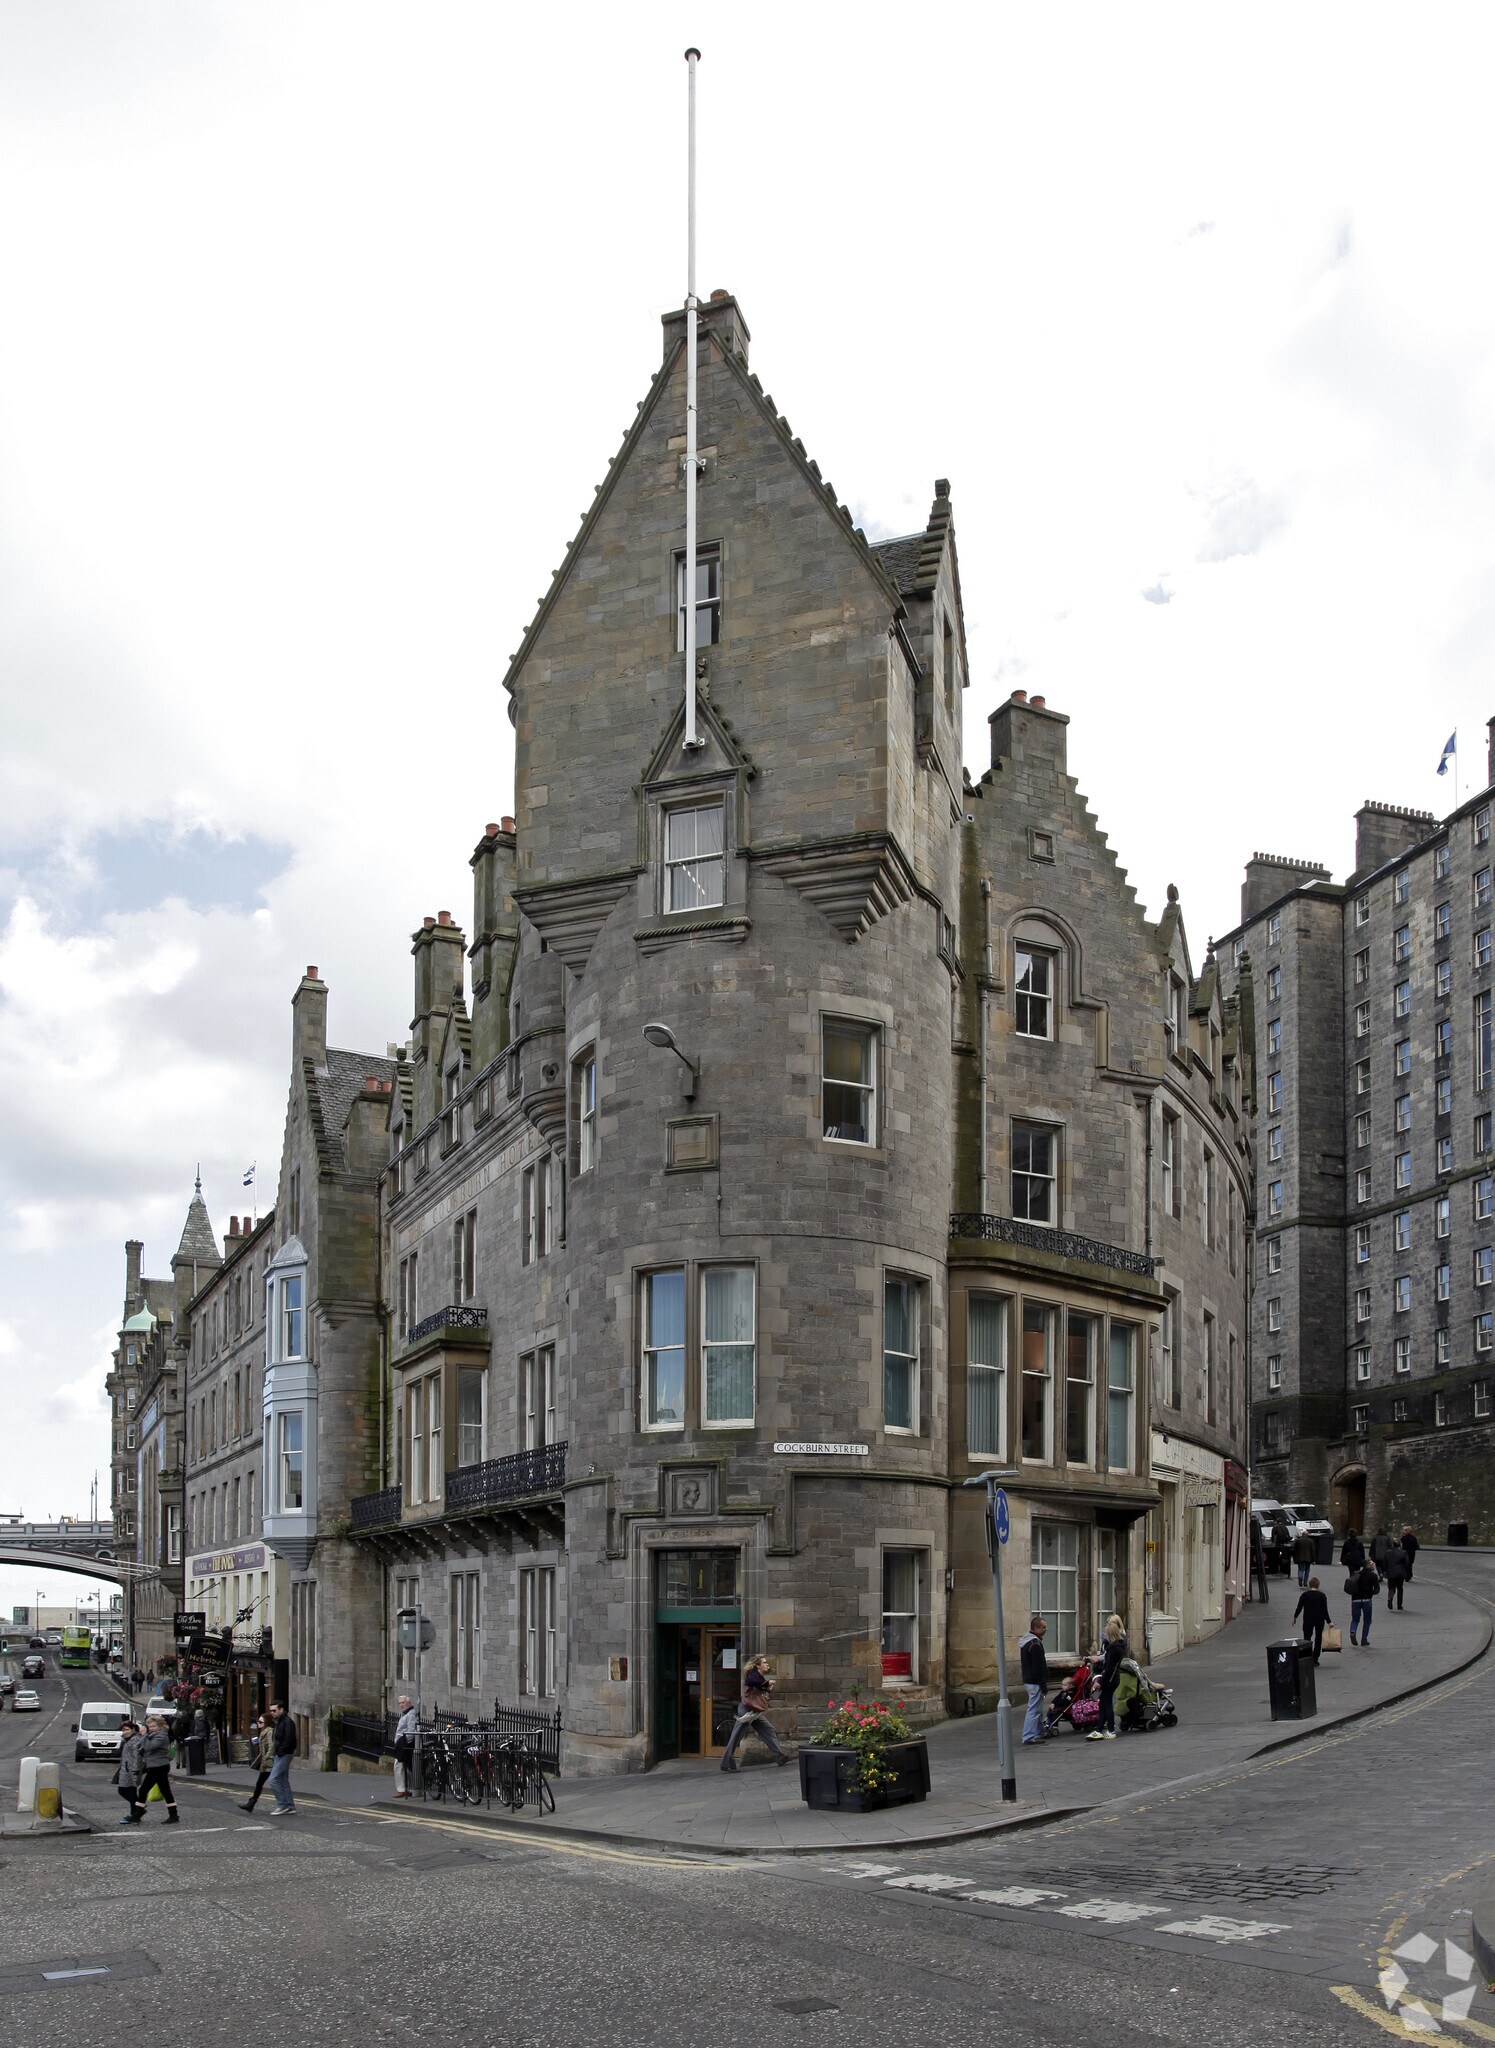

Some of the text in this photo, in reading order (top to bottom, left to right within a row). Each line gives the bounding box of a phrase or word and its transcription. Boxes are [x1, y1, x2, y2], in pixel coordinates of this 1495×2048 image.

[777, 1444, 865, 1454] COCKBURN STREET
[202, 1647, 217, 1656] The
[189, 1654, 225, 1666] Hebrides
